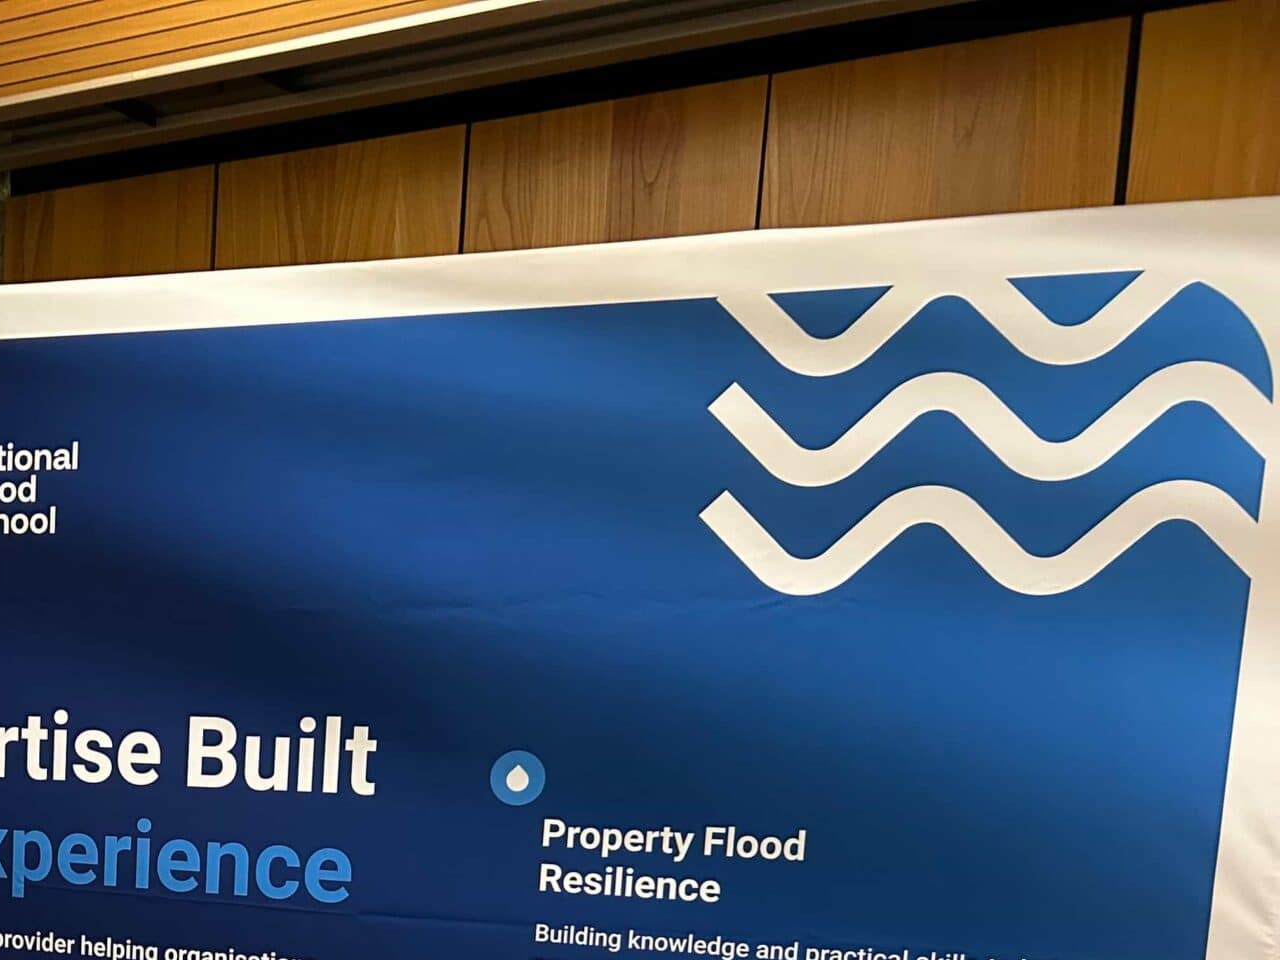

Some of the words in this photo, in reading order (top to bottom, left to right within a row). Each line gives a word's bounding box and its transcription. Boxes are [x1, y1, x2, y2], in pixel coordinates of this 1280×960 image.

[187, 716, 377, 795] Built
[543, 819, 694, 862] Property
[704, 827, 806, 860] Flood
[540, 864, 720, 902] Resilience
[536, 924, 621, 952] Building
[629, 930, 749, 960] knowledge
[756, 942, 798, 960] and
